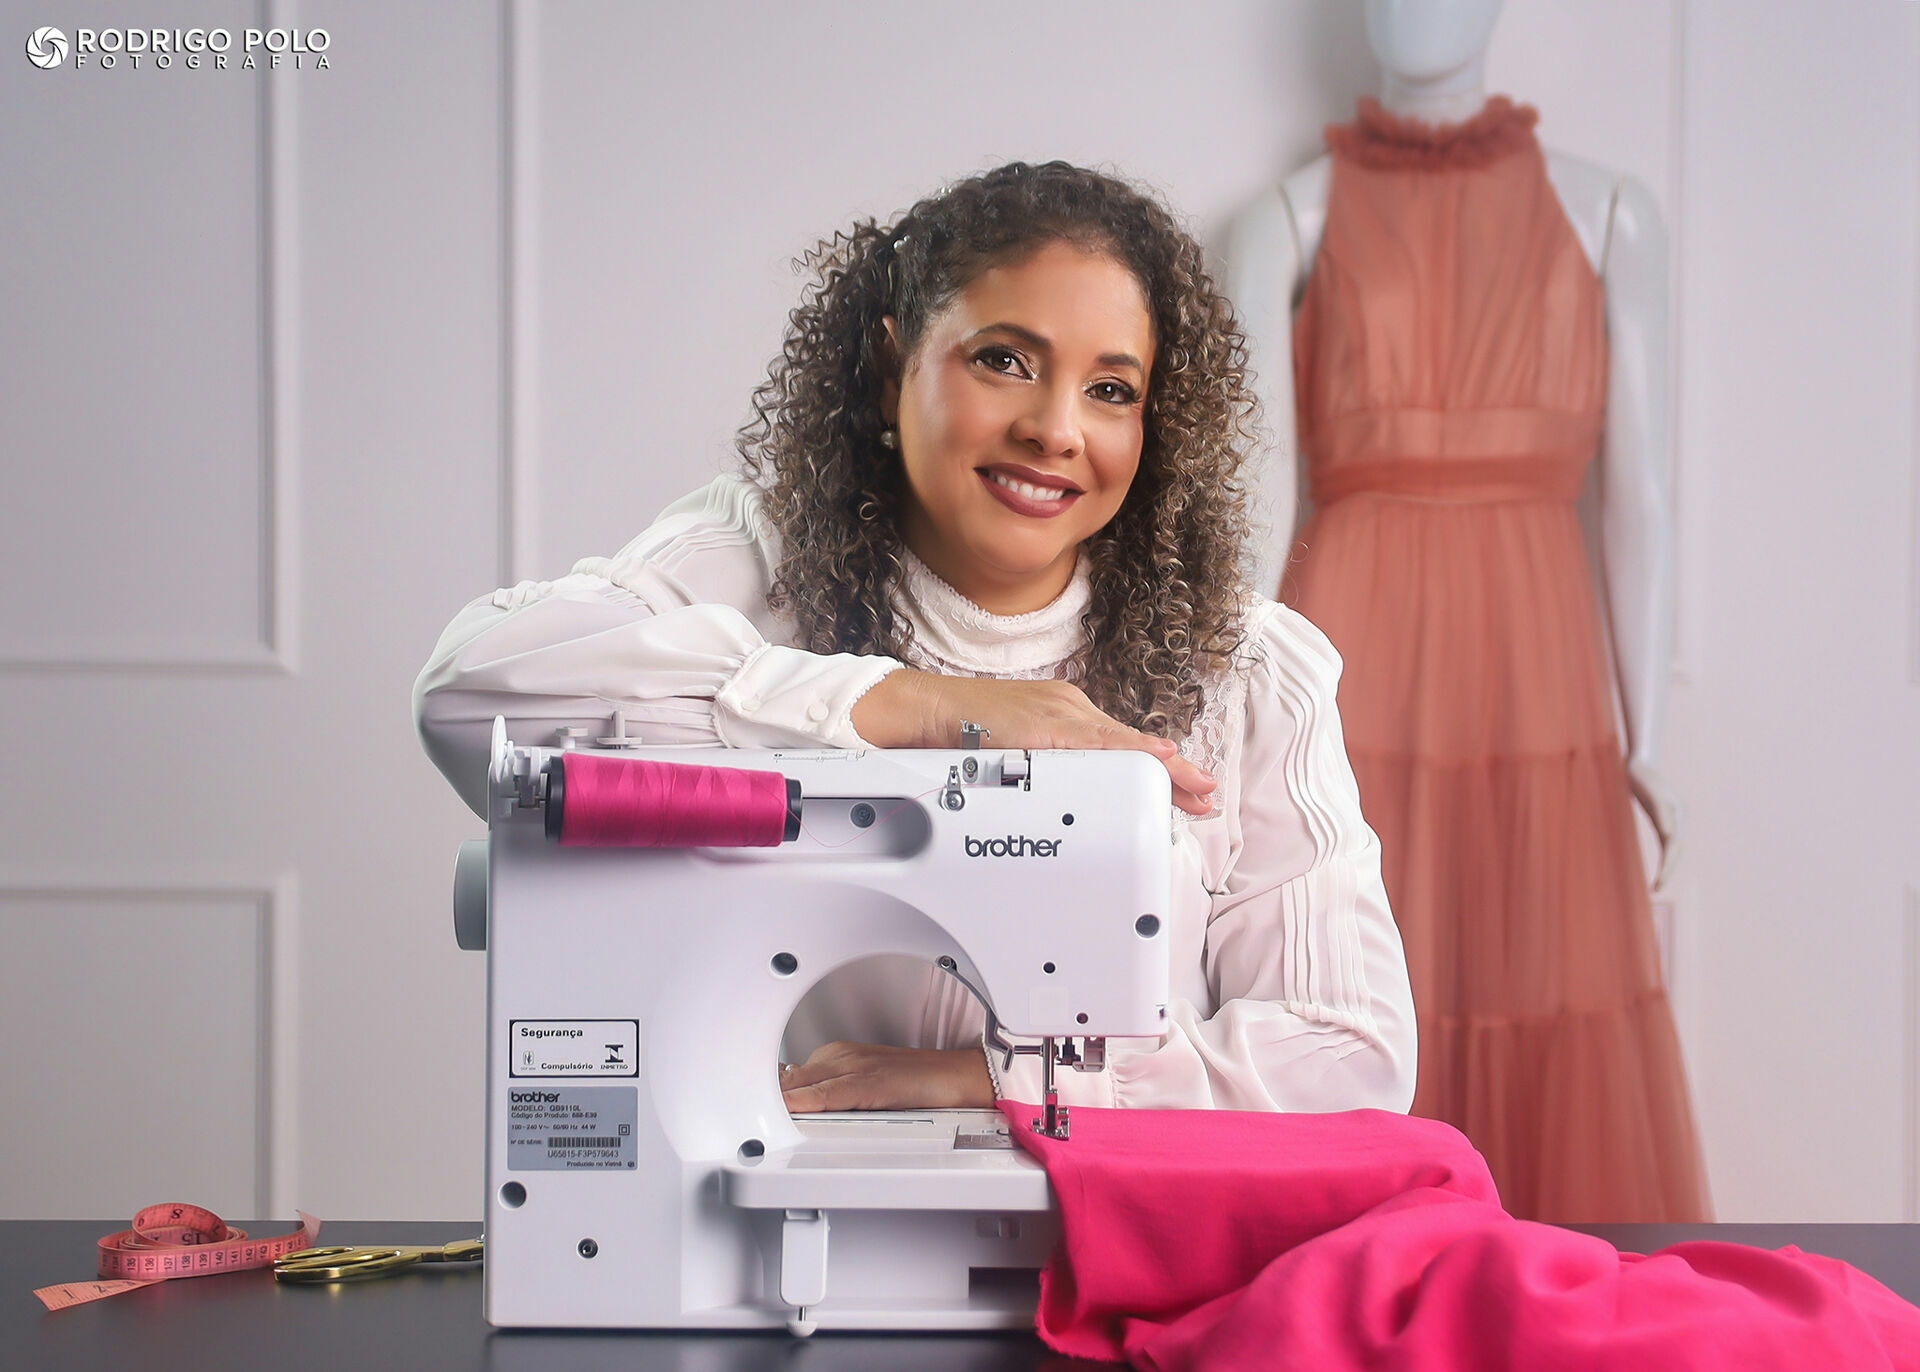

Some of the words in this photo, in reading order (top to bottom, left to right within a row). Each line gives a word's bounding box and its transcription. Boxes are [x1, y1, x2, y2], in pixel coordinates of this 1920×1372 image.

[965, 835, 1062, 857] brother
[521, 1028, 583, 1038] Segurança
[541, 1062, 593, 1070] Compulsório
[511, 1091, 560, 1102] brother
